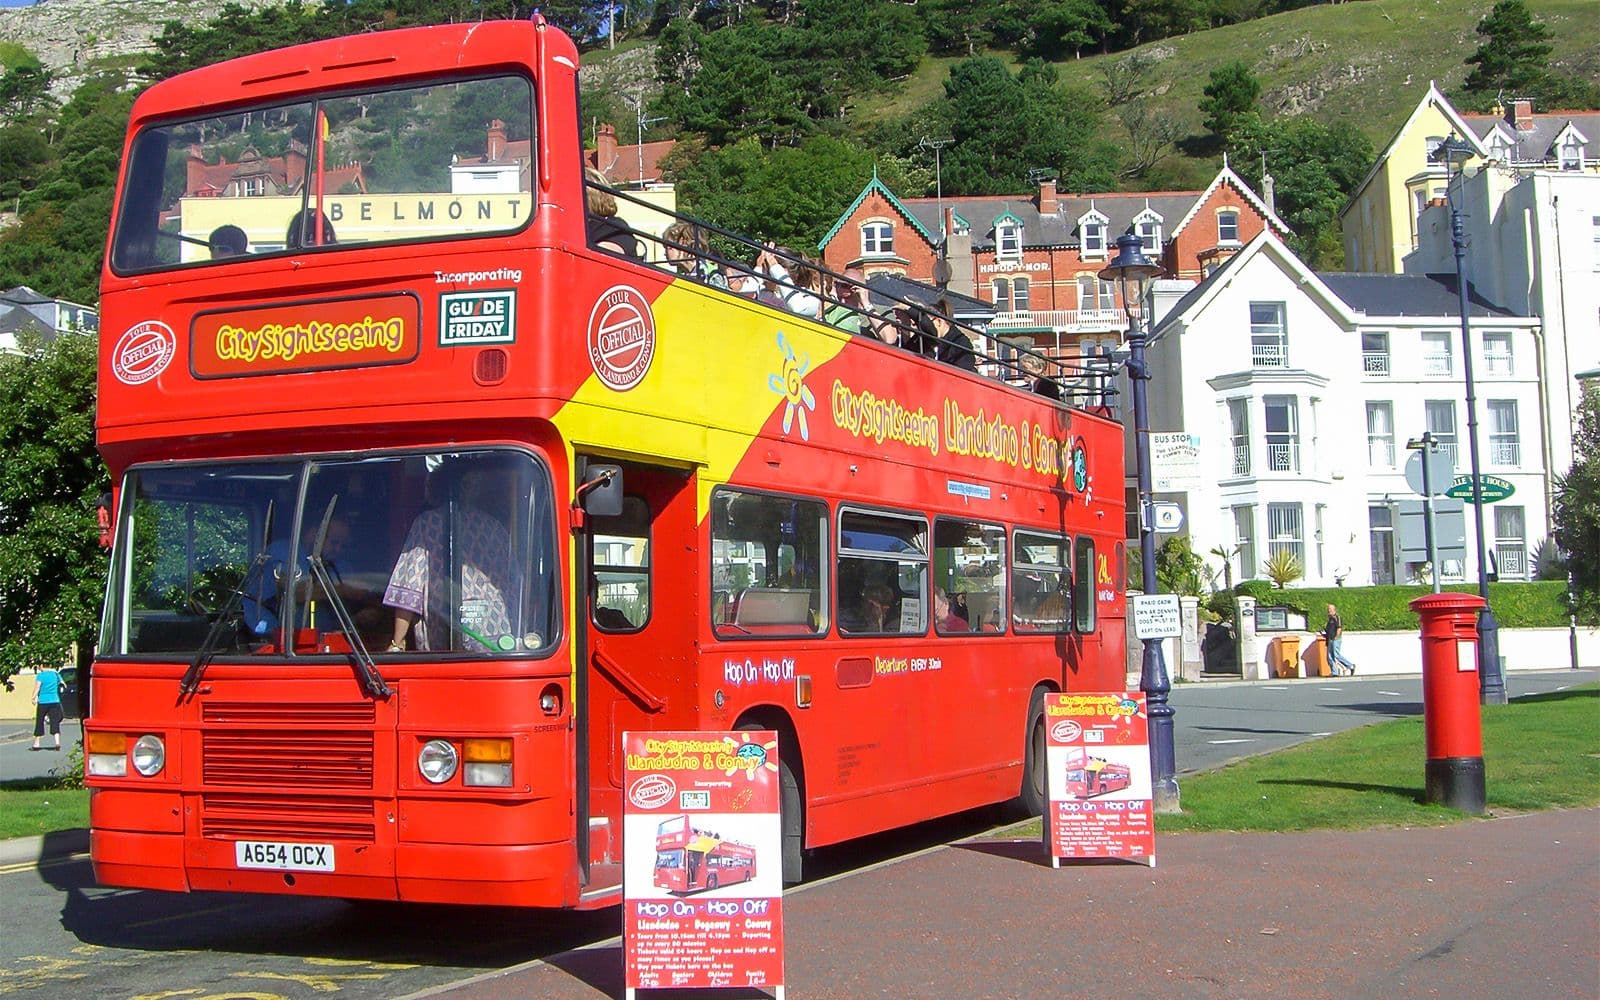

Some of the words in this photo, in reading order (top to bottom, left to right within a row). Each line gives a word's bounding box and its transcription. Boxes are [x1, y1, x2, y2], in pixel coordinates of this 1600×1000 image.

[330, 200, 521, 221] BELMONT
[434, 267, 522, 285] Incorporating
[607, 291, 630, 307] TOUR
[130, 325, 150, 338] TOUR
[216, 315, 404, 362] CitySightseeing
[449, 322, 504, 337] FRIDAY
[602, 324, 642, 352] OFFICIAL
[124, 341, 163, 365] OFFICIAL
[832, 378, 939, 456] CitySightseeing
[943, 397, 1018, 467] Llandudno
[1021, 420, 1032, 469] &
[1154, 435, 1169, 443] BUS
[1171, 435, 1191, 443] STOP
[724, 661, 744, 685] Hop
[745, 659, 758, 682] On
[763, 660, 781, 682] Hop
[782, 658, 795, 680] Off
[875, 656, 908, 674] Departures
[627, 752, 701, 771] Llandudno
[702, 753, 714, 770] &
[1059, 802, 1080, 812] Hop
[1082, 801, 1097, 811] On
[1104, 801, 1125, 811] Hop
[1127, 800, 1144, 810] Off
[244, 844, 287, 864] A654
[292, 846, 326, 866] OCX
[637, 902, 669, 917] Hop
[673, 901, 695, 915] On
[707, 901, 739, 916] Hop
[743, 900, 768, 914] Off
[637, 920, 679, 930] Llandudno
[694, 919, 730, 931] Deganwy
[744, 919, 771, 930] Conwy
[742, 931, 771, 940] Departing
[639, 971, 659, 979] Adults
[745, 970, 765, 978] Family
